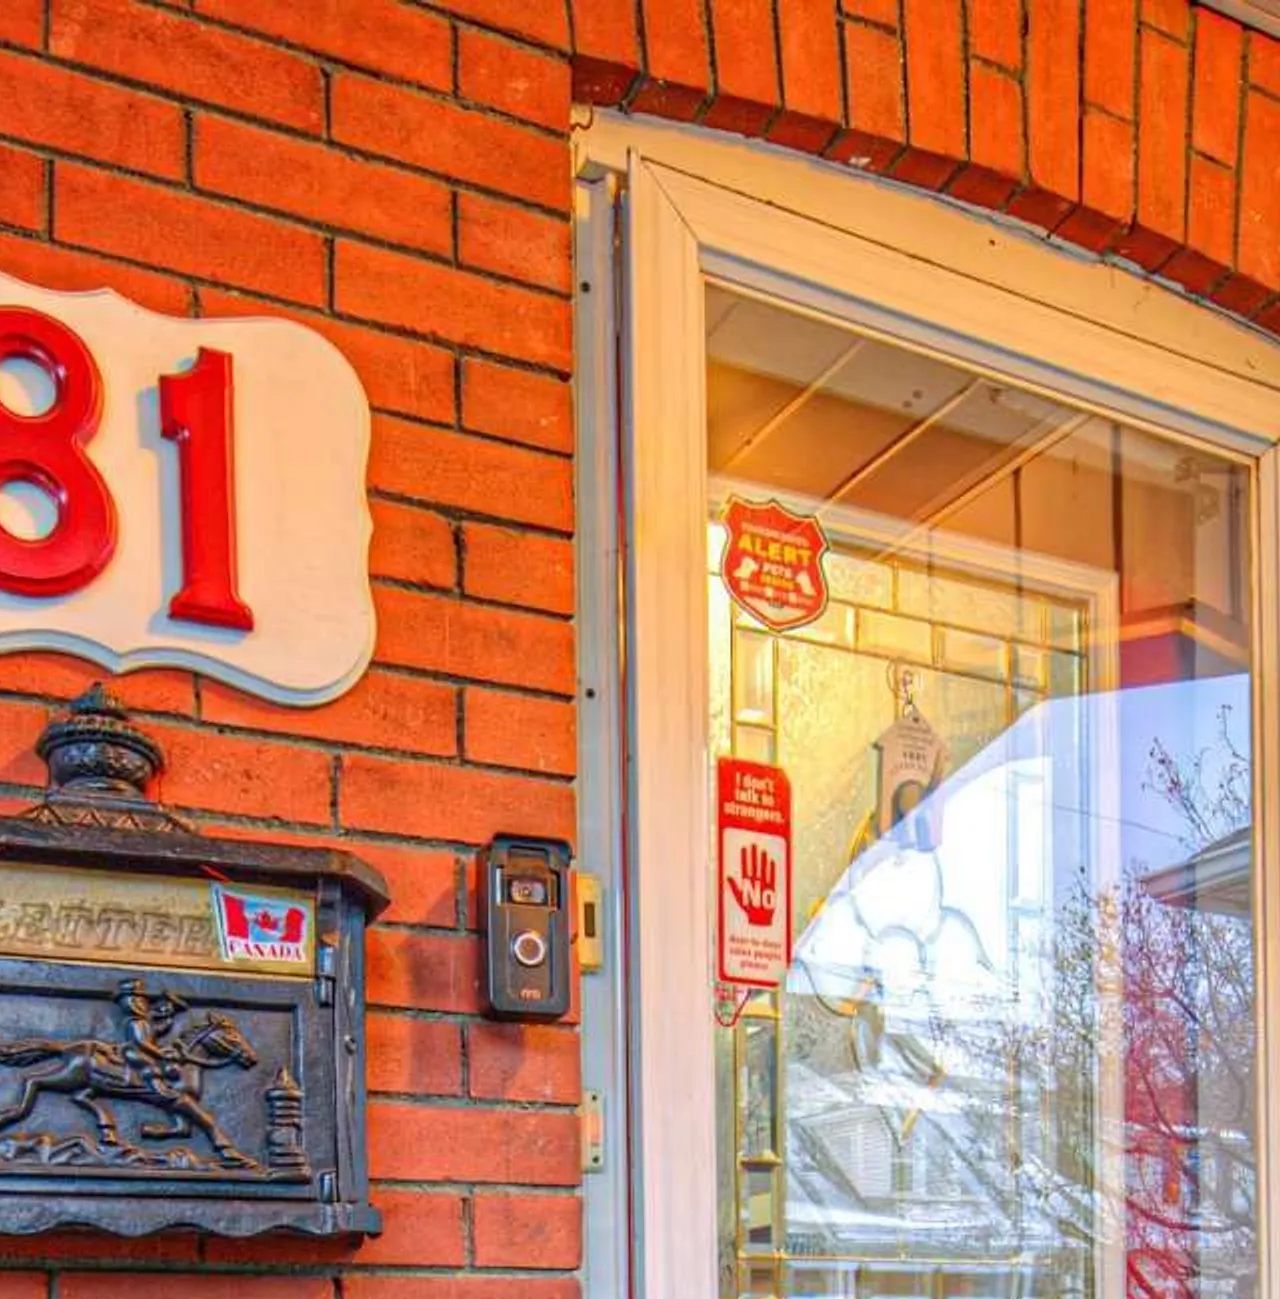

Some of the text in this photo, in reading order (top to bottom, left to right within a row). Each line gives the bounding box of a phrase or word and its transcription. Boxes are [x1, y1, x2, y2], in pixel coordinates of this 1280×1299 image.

[738, 532, 814, 569] ALERT
[735, 771, 741, 788] I
[742, 878, 776, 910] No
[228, 938, 303, 961] CANADA
